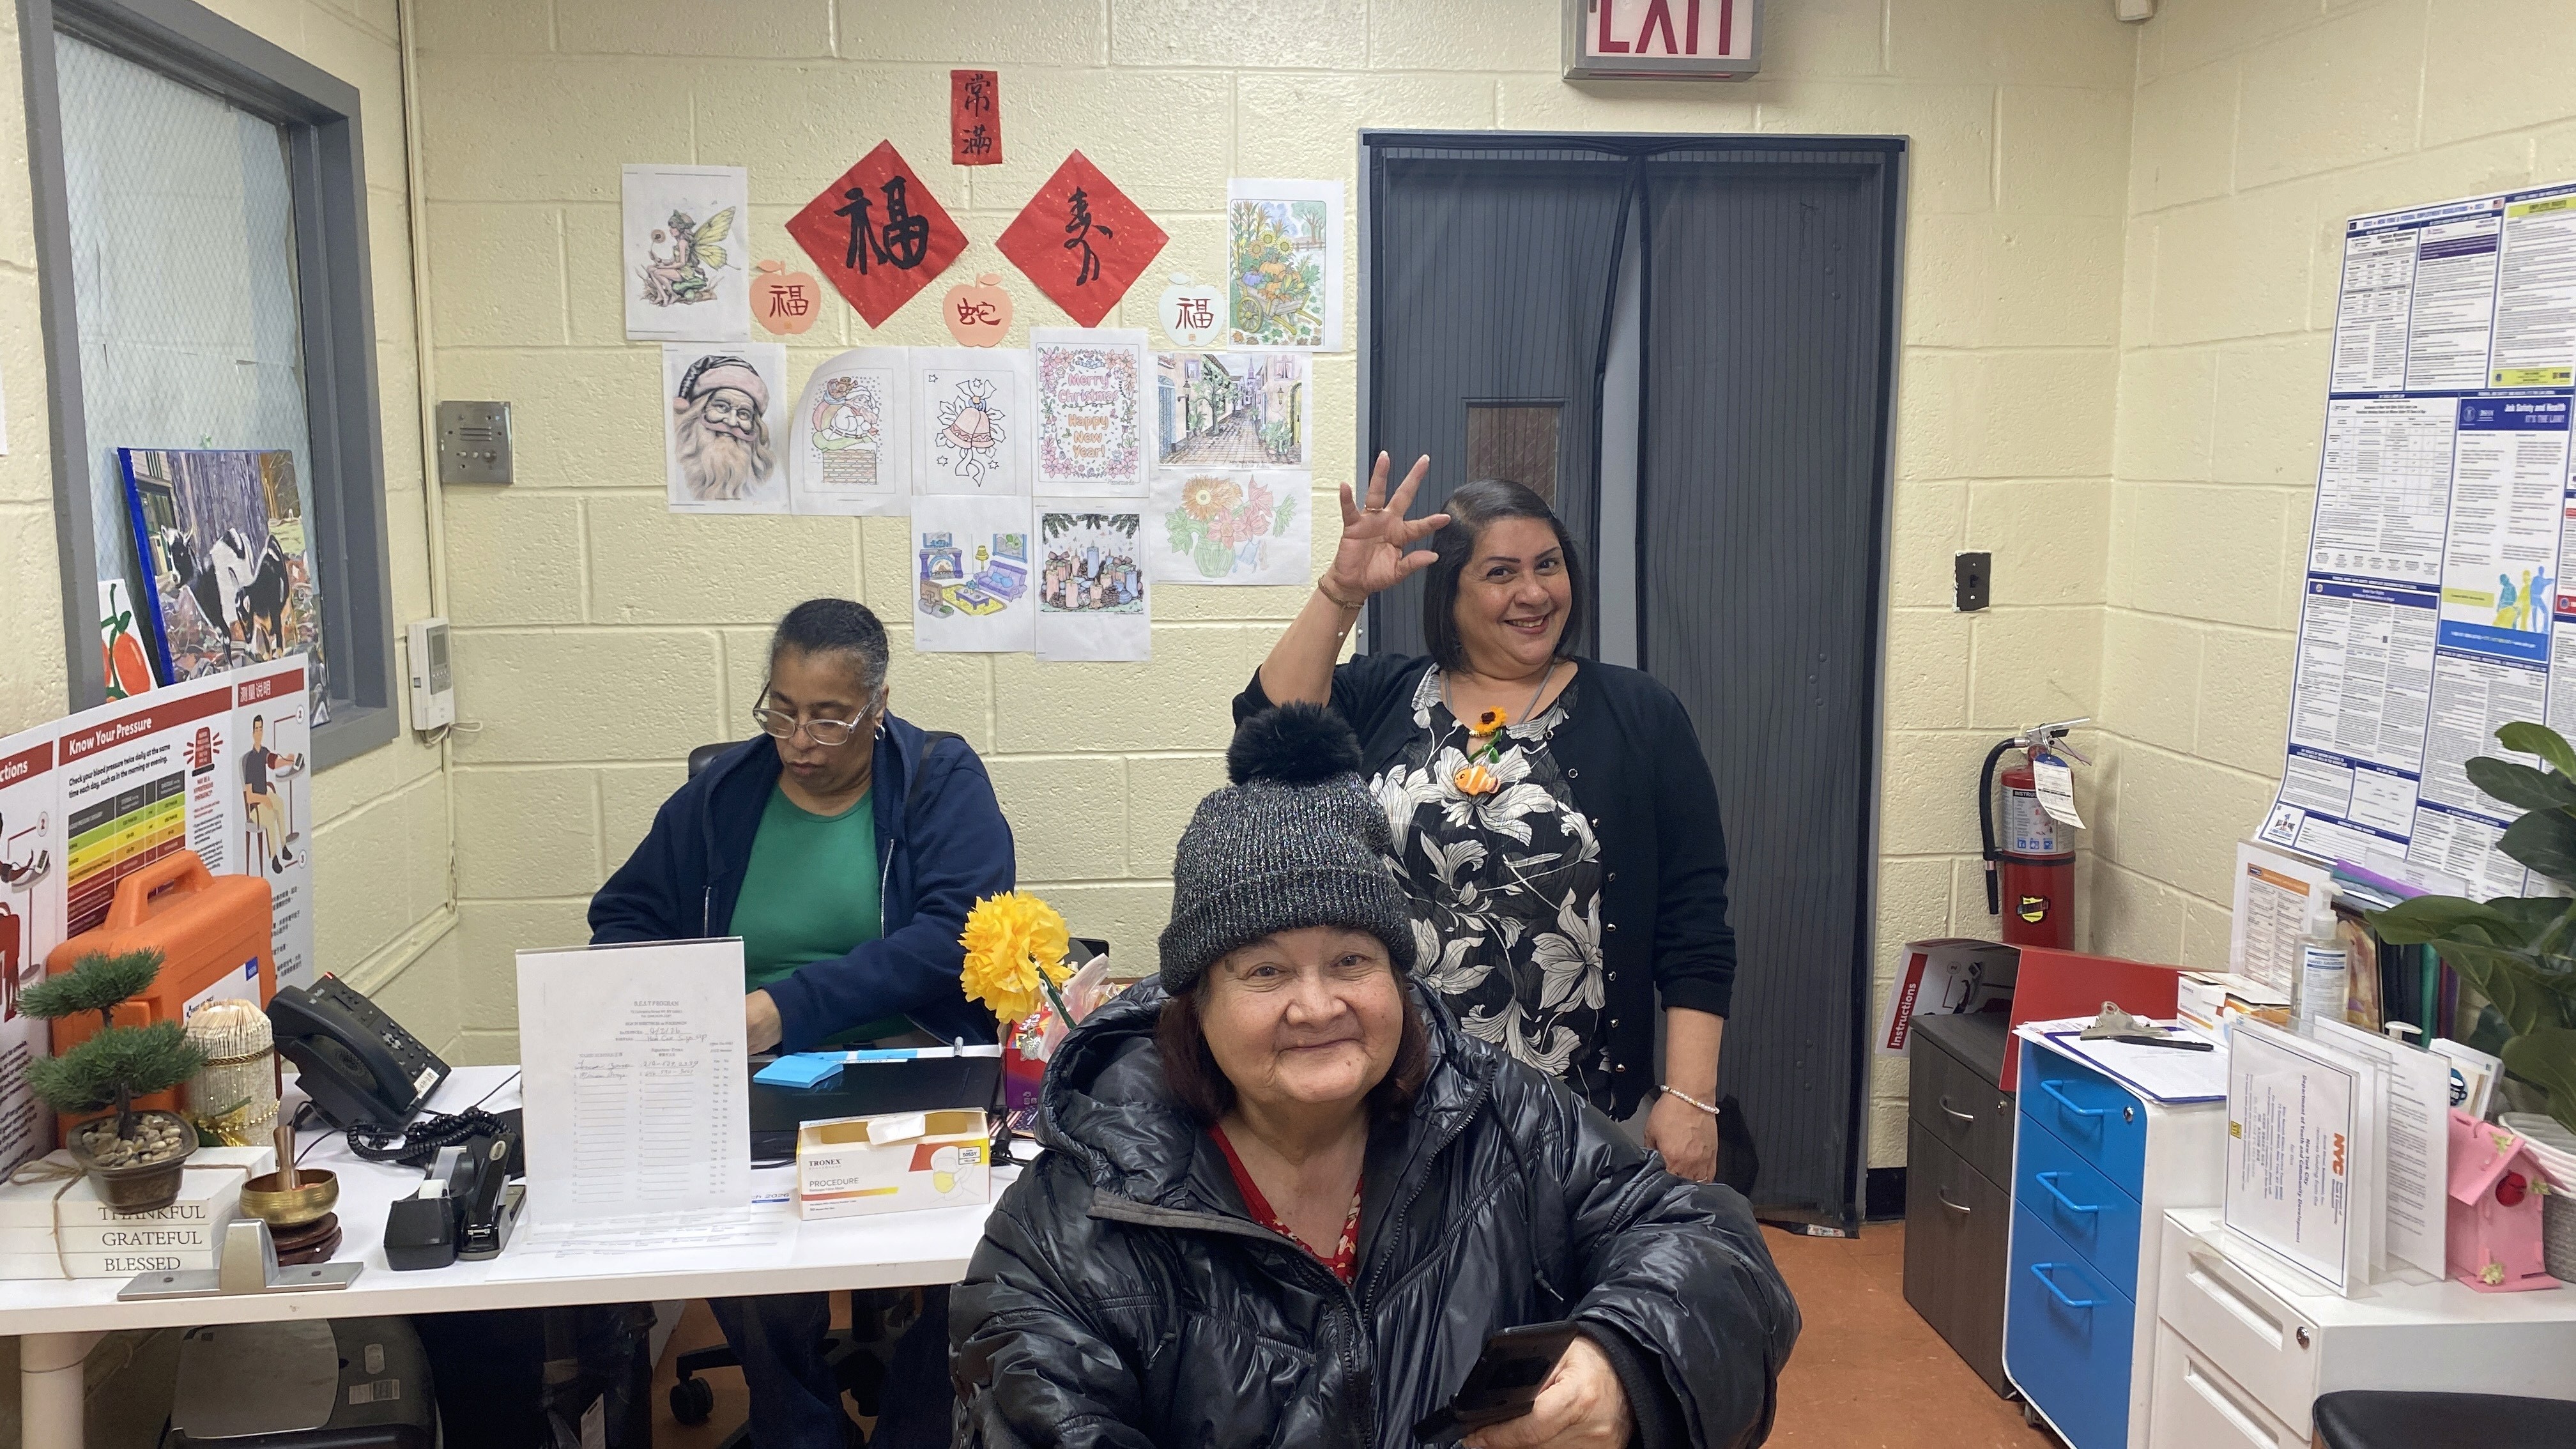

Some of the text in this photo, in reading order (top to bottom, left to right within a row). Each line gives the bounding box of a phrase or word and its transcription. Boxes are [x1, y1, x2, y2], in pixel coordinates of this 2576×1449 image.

[834, 176, 930, 275] 福
[769, 284, 809, 318] 福
[956, 297, 1001, 326] 蛇
[1175, 297, 1214, 330] 福
[1068, 373, 1109, 390] Merry
[1058, 388, 1119, 404] Christmas
[1068, 413, 1109, 431] Happy
[1073, 431, 1103, 443] New
[1072, 444, 1105, 459] Year!
[69, 717, 152, 756] Know Your Pressure
[1890, 983, 1916, 1046] Instructions
[2301, 1116, 2306, 1124] of
[2333, 1133, 2345, 1176] NYC
[809, 1177, 859, 1187] PROCEDURE
[102, 1231, 203, 1246] GRATEFUL
[104, 1257, 181, 1271] BLESSED
